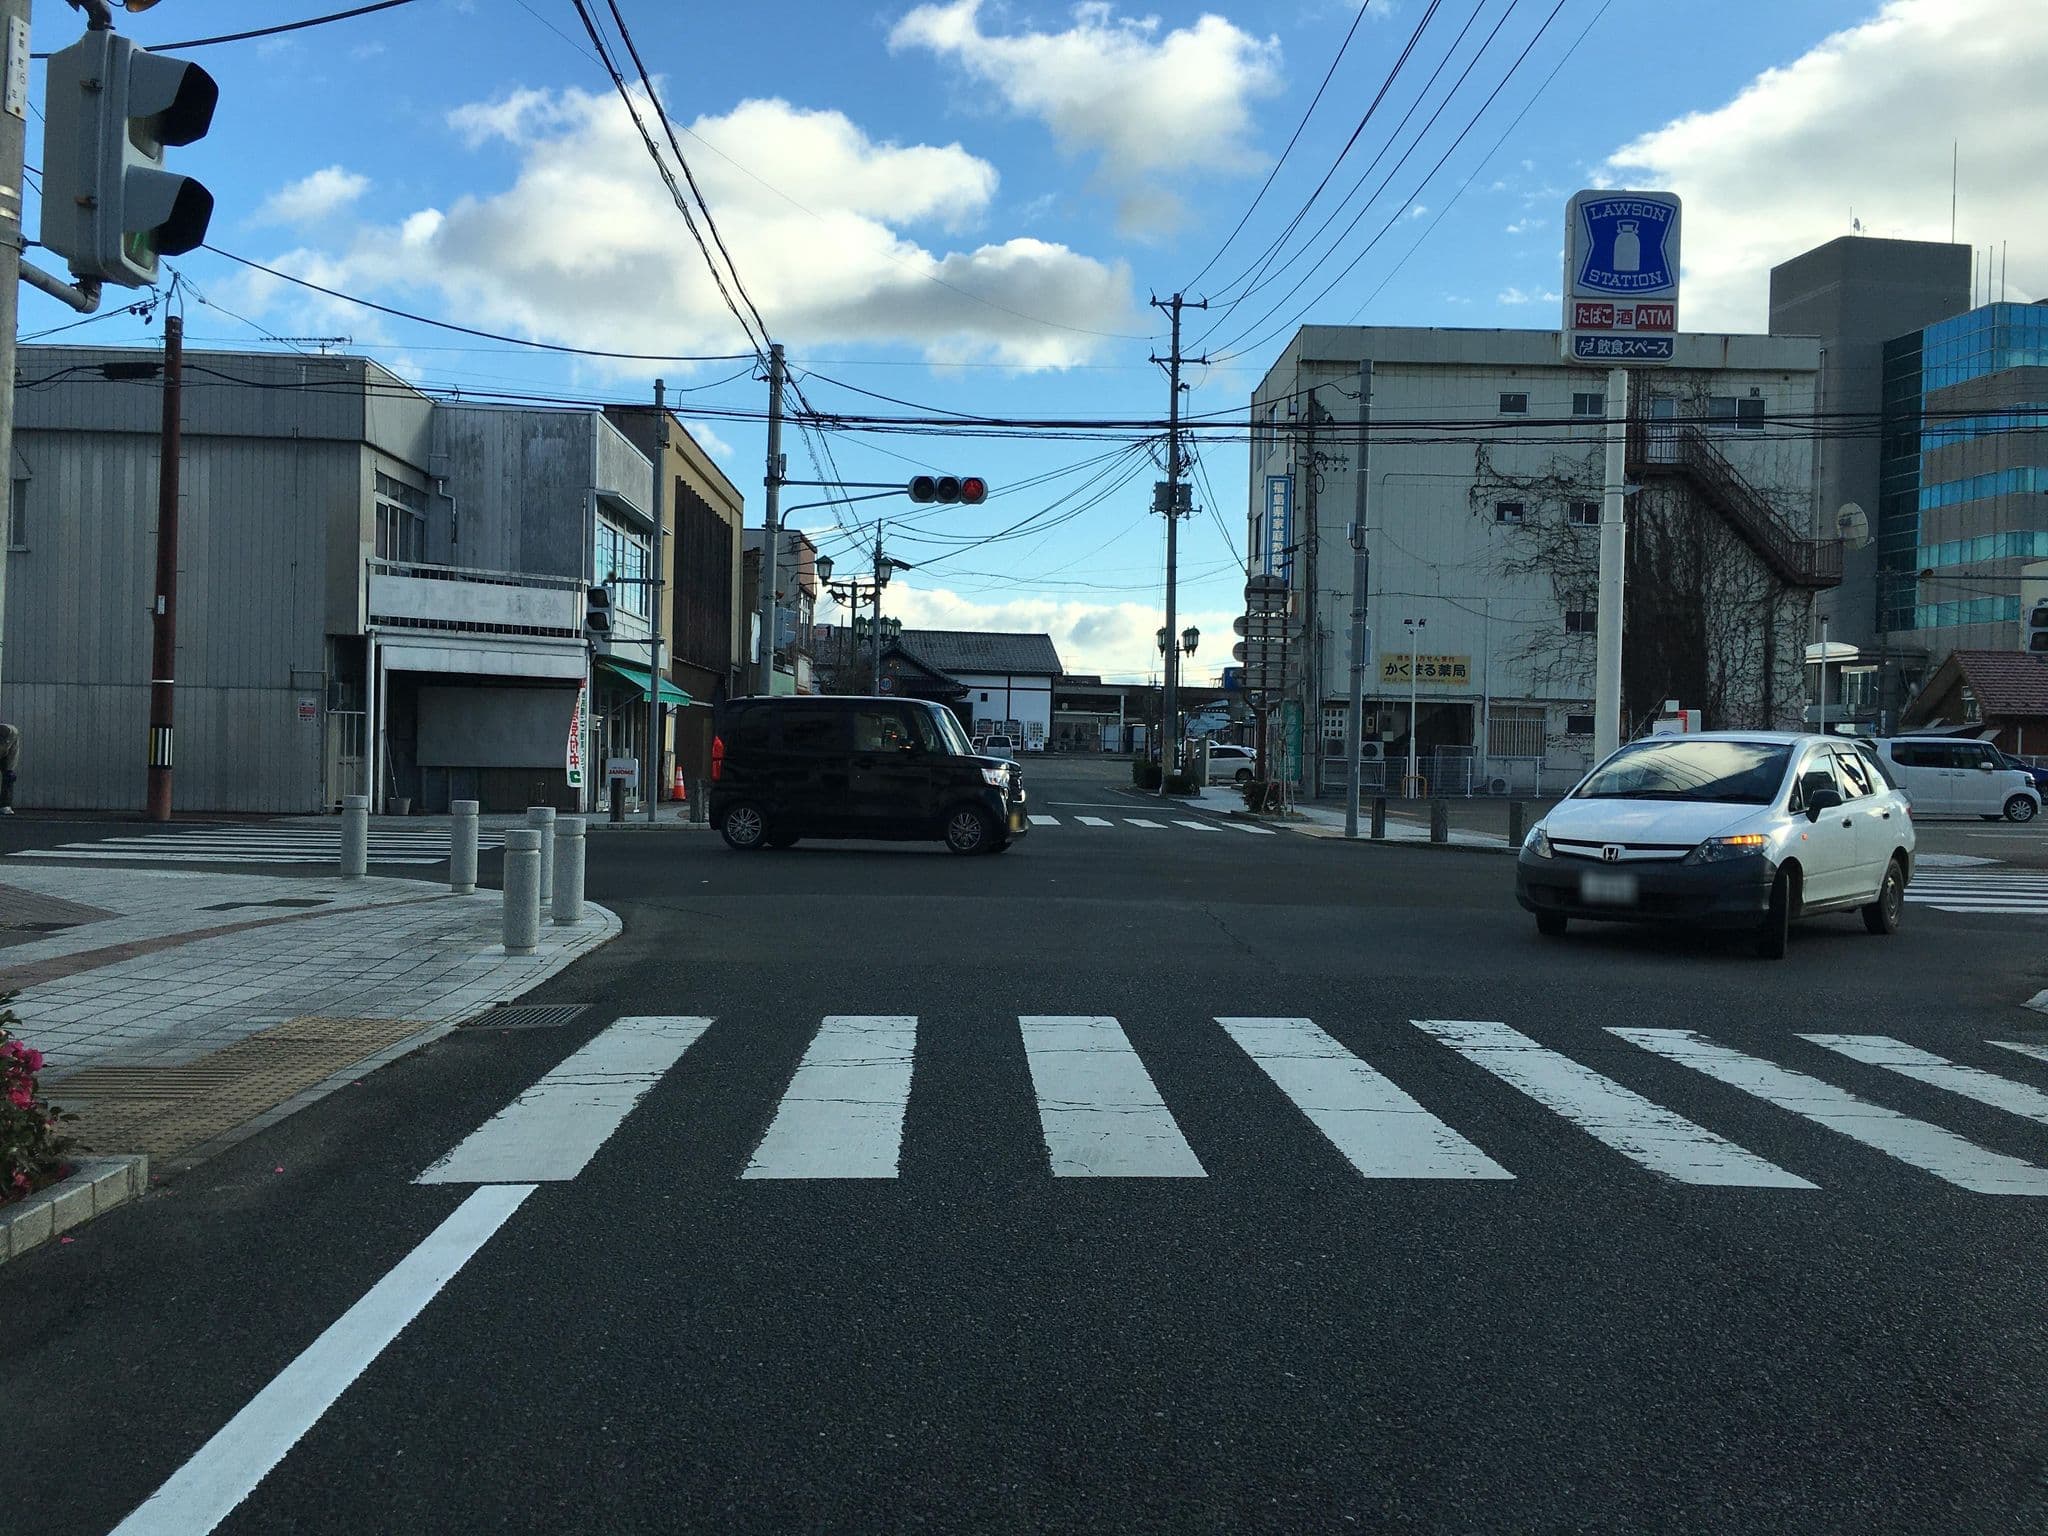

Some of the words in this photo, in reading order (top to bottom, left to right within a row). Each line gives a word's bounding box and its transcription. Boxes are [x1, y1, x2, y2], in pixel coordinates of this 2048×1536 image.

[1589, 203, 1667, 222] LAWSON
[1589, 269, 1664, 287] STATION
[1577, 307, 1613, 324] たばこ
[1615, 309, 1635, 325] 酒
[1637, 309, 1672, 325] ATM
[1597, 340, 1669, 355] 飲食スペース
[1385, 662, 1466, 677] かくまる薬局
